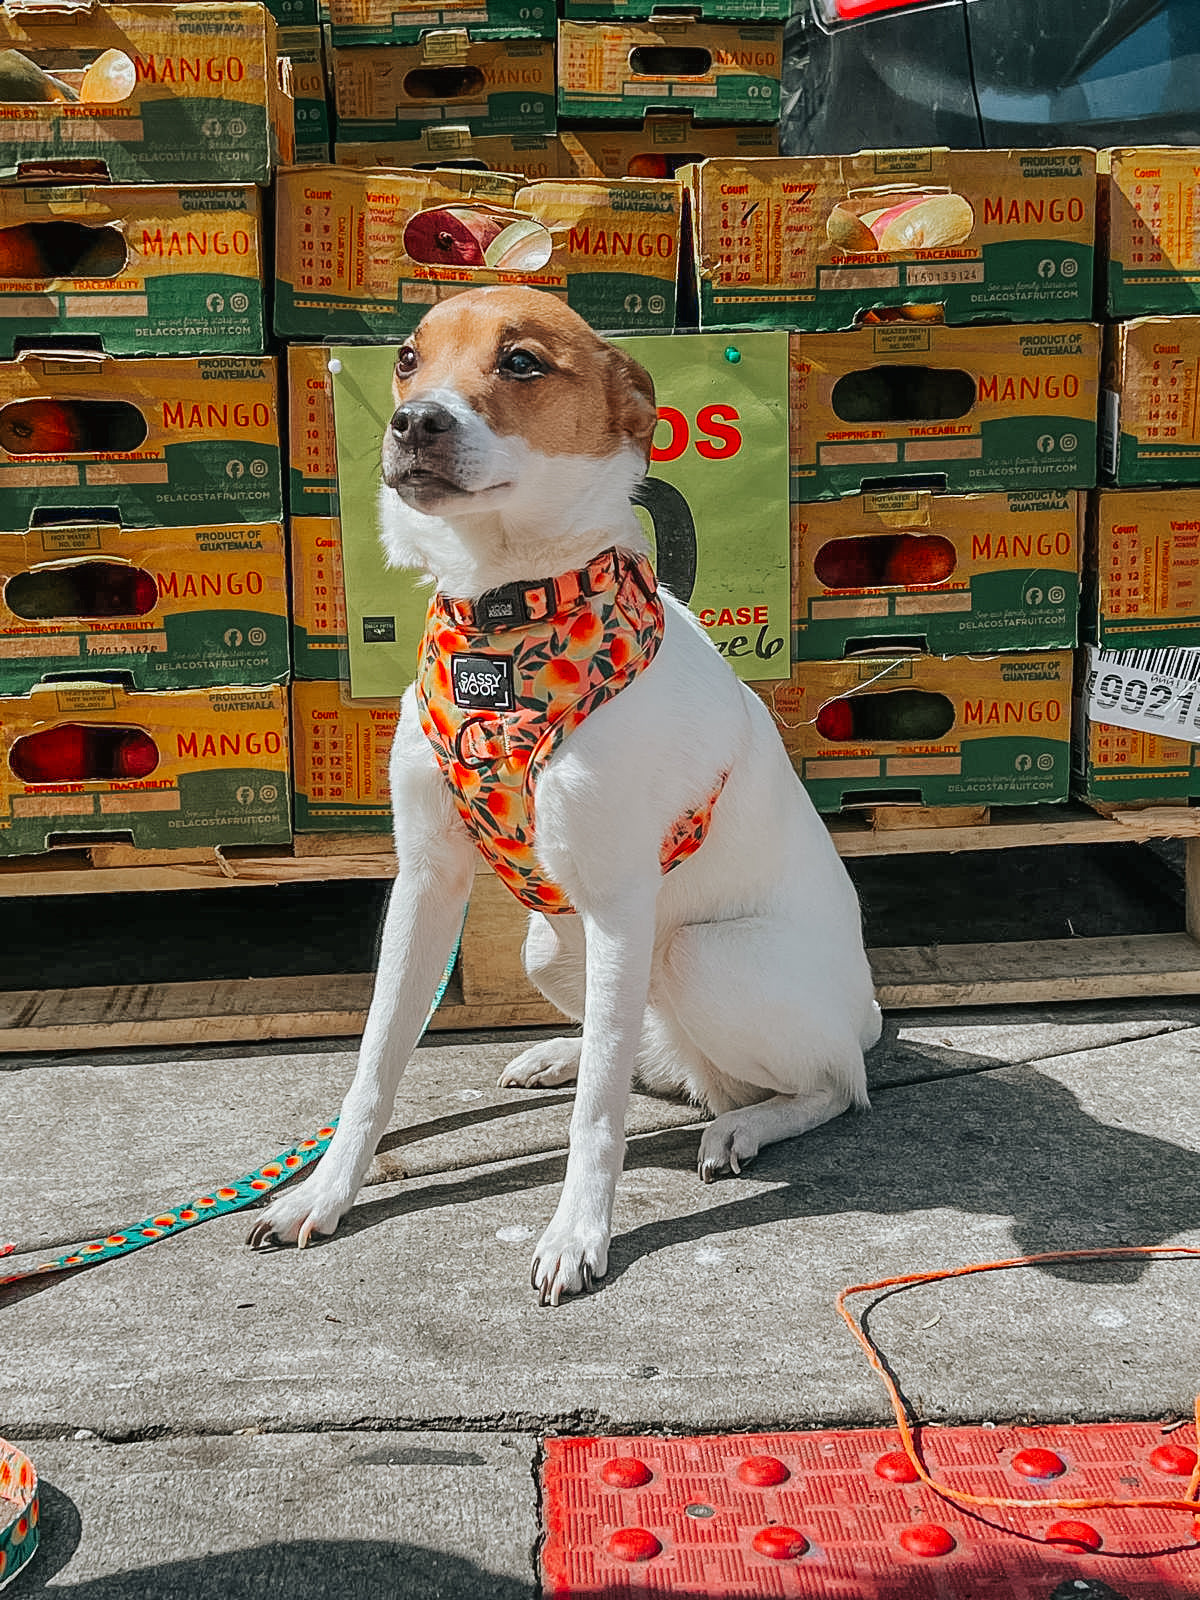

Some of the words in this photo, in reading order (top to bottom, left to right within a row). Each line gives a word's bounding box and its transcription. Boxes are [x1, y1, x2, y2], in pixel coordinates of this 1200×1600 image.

[176, 12, 226, 21] PRODUCT
[228, 12, 242, 20] OF
[716, 50, 775, 66] MANGO
[135, 55, 244, 83] MANGO
[64, 107, 132, 117] TRACEABILITY
[1020, 157, 1065, 166] PRODUCT
[1069, 156, 1082, 165] OF
[1023, 168, 1083, 178] GUATEMALA
[1134, 168, 1161, 178] Count
[304, 188, 332, 200] Count
[721, 184, 748, 195] Count
[1136, 185, 1142, 194] 6
[1153, 185, 1160, 194] 7
[178, 190, 228, 200] PRODUCT
[231, 190, 245, 199] OF
[367, 192, 401, 205] Variety
[609, 191, 657, 200] PRODUCT
[660, 192, 674, 201] OF
[183, 201, 247, 211] GUATEMALA
[612, 203, 674, 212] GUATEMALA
[721, 202, 729, 211] 6
[741, 202, 748, 210] 7
[984, 196, 1084, 224] MANGO
[1135, 202, 1141, 210] 8
[1153, 202, 1160, 210] 9
[305, 207, 312, 216] 6
[324, 207, 330, 217] 7
[721, 220, 729, 229] 8
[741, 220, 748, 228] 9
[1132, 219, 1143, 228] 10
[1151, 219, 1161, 227] 12
[141, 228, 249, 257] MANGO
[302, 241, 314, 250] 10
[569, 226, 673, 257] MANGO
[720, 238, 732, 246] 10
[738, 237, 751, 246] 12
[320, 242, 332, 252] 12
[720, 255, 731, 264] 14
[738, 255, 750, 263] 16
[831, 256, 875, 265] SHIPPING
[877, 254, 892, 263] BY:
[915, 250, 979, 260] TRACEABILITY
[1132, 253, 1143, 262] 18
[1150, 253, 1161, 262] 20
[302, 259, 313, 268] 14
[320, 260, 332, 269] 16
[301, 276, 313, 286] 18
[497, 274, 562, 285] TRACEABILITY
[720, 272, 731, 282] 18
[737, 272, 750, 281] 20
[73, 280, 139, 290] TRACEABILITY
[319, 277, 332, 286] 20
[971, 290, 1078, 302] DELACOSTAFRUIT.COM
[136, 326, 250, 337] DELACOSTAFRUIT.COM
[1019, 336, 1066, 345] PRODUCT
[1069, 334, 1082, 344] OF
[1022, 346, 1082, 356] GUATEMALA
[1153, 344, 1180, 354] Count
[1153, 360, 1160, 369] 6
[1171, 361, 1178, 369] 7
[202, 370, 266, 380] GUATEMALA
[1152, 377, 1158, 386] 8
[1170, 377, 1177, 386] 9
[978, 374, 1079, 402] MANGO
[308, 396, 315, 405] 6
[1150, 394, 1160, 403] 10
[1167, 394, 1178, 403] 12
[163, 401, 269, 429] MANGO
[308, 413, 315, 422] 8
[1148, 411, 1159, 420] 14
[1166, 411, 1177, 420] 16
[306, 430, 319, 439] 10
[908, 425, 973, 436] TRACEABILITY
[1148, 427, 1158, 436] 18
[1164, 427, 1177, 436] 20
[826, 432, 869, 441] SHIPPING
[870, 430, 886, 439] BY:
[306, 447, 319, 455] 14
[307, 464, 319, 472] 18
[969, 464, 1077, 477] DELACOSTAFRUIT.COM
[156, 491, 270, 502] DELACOSTAFRUIT.COM
[1008, 492, 1053, 501] PRODUCT
[1056, 491, 1067, 499] OF
[1010, 501, 1069, 512] GUATEMALA
[1112, 525, 1138, 534] Count
[196, 531, 245, 541] PRODUCT
[249, 530, 262, 539] OF
[200, 541, 263, 551] GUATEMALA
[972, 532, 1071, 560] MANGO
[1112, 541, 1119, 549] 6
[1131, 540, 1137, 548] 7
[317, 554, 323, 562] 6
[1112, 557, 1118, 566] 8
[1130, 556, 1137, 565] 9
[317, 570, 324, 579] 8
[1110, 573, 1121, 582] 10
[1127, 572, 1139, 581] 12
[157, 571, 263, 598] MANGO
[315, 587, 326, 595] 10
[1110, 588, 1121, 597] 14
[1127, 588, 1139, 597] 16
[316, 603, 326, 611] 14
[1110, 604, 1120, 613] 18
[1126, 604, 1138, 612] 20
[700, 606, 768, 626] CASE
[89, 622, 155, 631] TRACEABILITY
[316, 619, 327, 628] 18
[959, 615, 1066, 630] DELACOSTAFRUIT.COM
[156, 658, 269, 671] DELACOSTAFRUIT.COM
[1000, 663, 1045, 672] PRODUCT
[1047, 661, 1060, 670] OF
[460, 672, 502, 687] SASSY
[1002, 672, 1060, 681] GUATEMALA
[459, 682, 497, 696] WOOF
[208, 693, 257, 702] PRODUCT
[260, 692, 273, 700] OF
[213, 702, 275, 713] GUATEMALA
[964, 700, 1061, 724] MANGO
[311, 710, 338, 720] Count
[313, 725, 320, 734] 6
[331, 726, 337, 734] 7
[177, 731, 281, 758] MANGO
[313, 741, 320, 749] 8
[332, 741, 338, 749] 9
[1099, 738, 1109, 747] 14
[1116, 738, 1126, 747] 16
[312, 757, 323, 765] 10
[330, 757, 341, 765] 12
[1099, 753, 1108, 762] 18
[1114, 753, 1126, 762] 20
[312, 772, 323, 781] 14
[330, 772, 341, 781] 16
[109, 780, 174, 790] TRACEABILITY
[948, 781, 1054, 793] DELACOSTAFRUIT.COM
[312, 788, 323, 796] 18
[329, 788, 342, 796] 20
[168, 815, 280, 828] DELACOSTAFRUIT.COM
